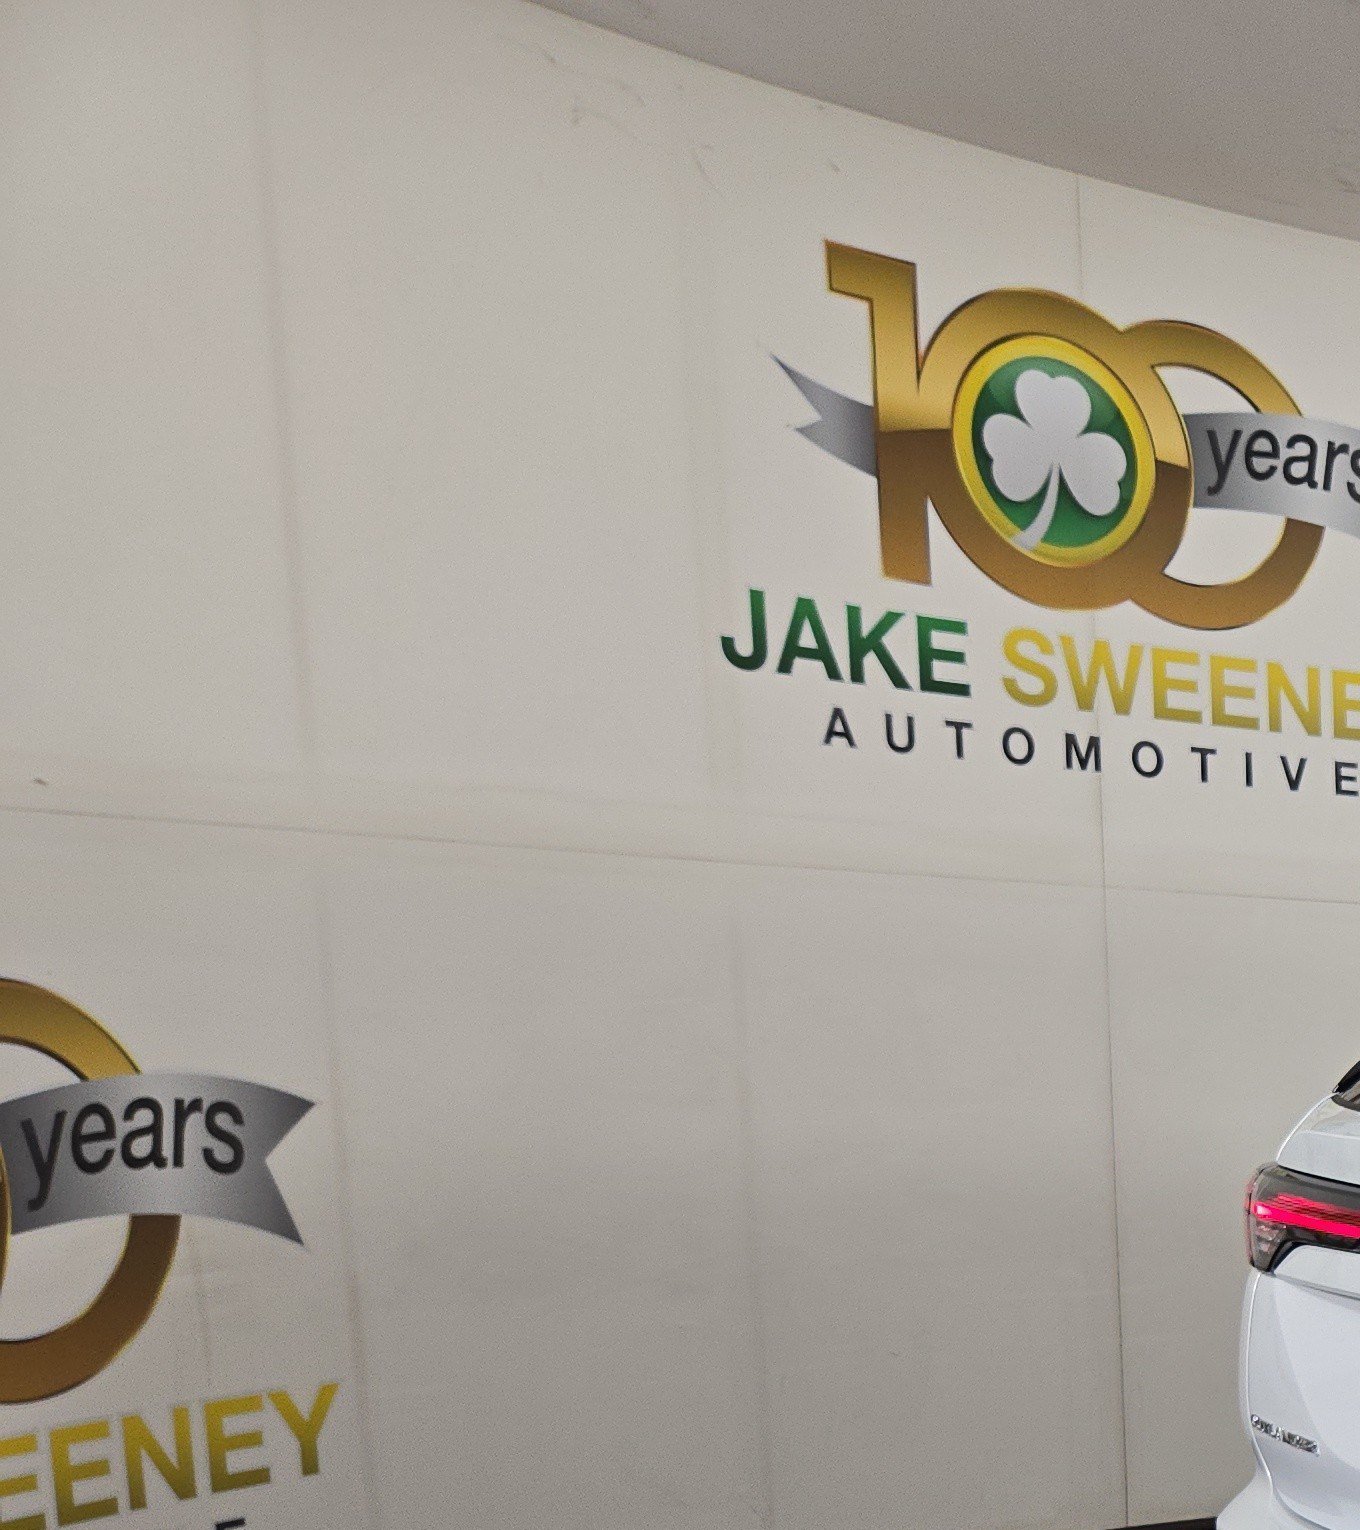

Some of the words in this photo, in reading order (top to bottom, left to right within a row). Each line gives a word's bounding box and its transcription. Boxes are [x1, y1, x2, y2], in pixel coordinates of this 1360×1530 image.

[720, 588, 973, 698] JAKE
[823, 706, 1360, 797] AUTOMOTIVE
[20, 1095, 245, 1212] years
